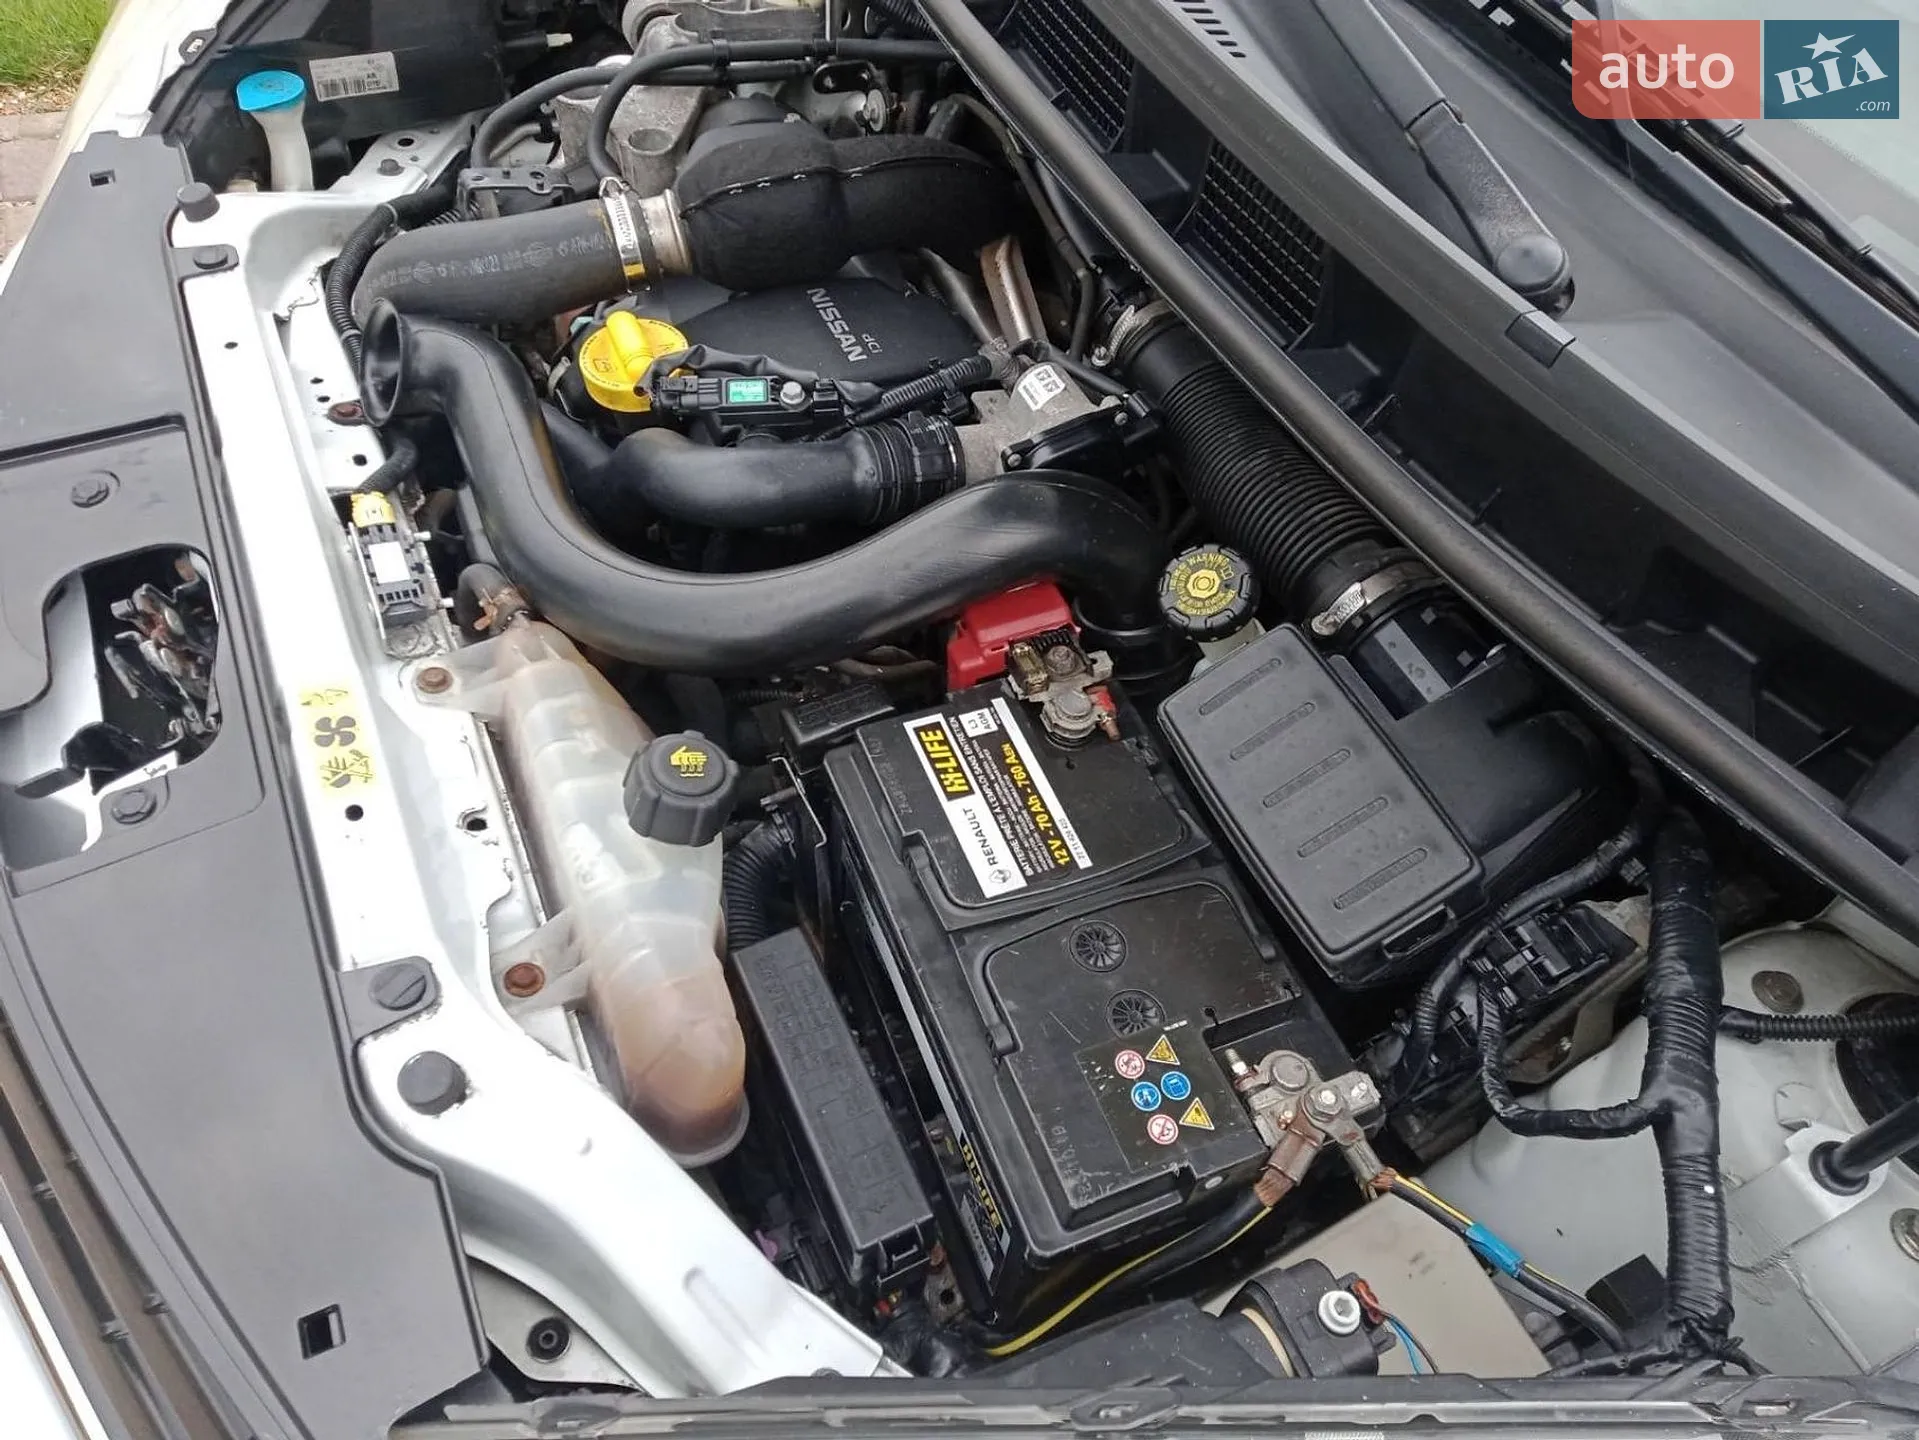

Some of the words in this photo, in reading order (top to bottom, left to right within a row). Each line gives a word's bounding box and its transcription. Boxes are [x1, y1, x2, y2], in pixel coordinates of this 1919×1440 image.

[806, 286, 867, 362] NISSAN
[860, 331, 882, 354] dCi
[962, 806, 998, 866] RENAULT
[1010, 839, 1034, 877] BATTERIE
